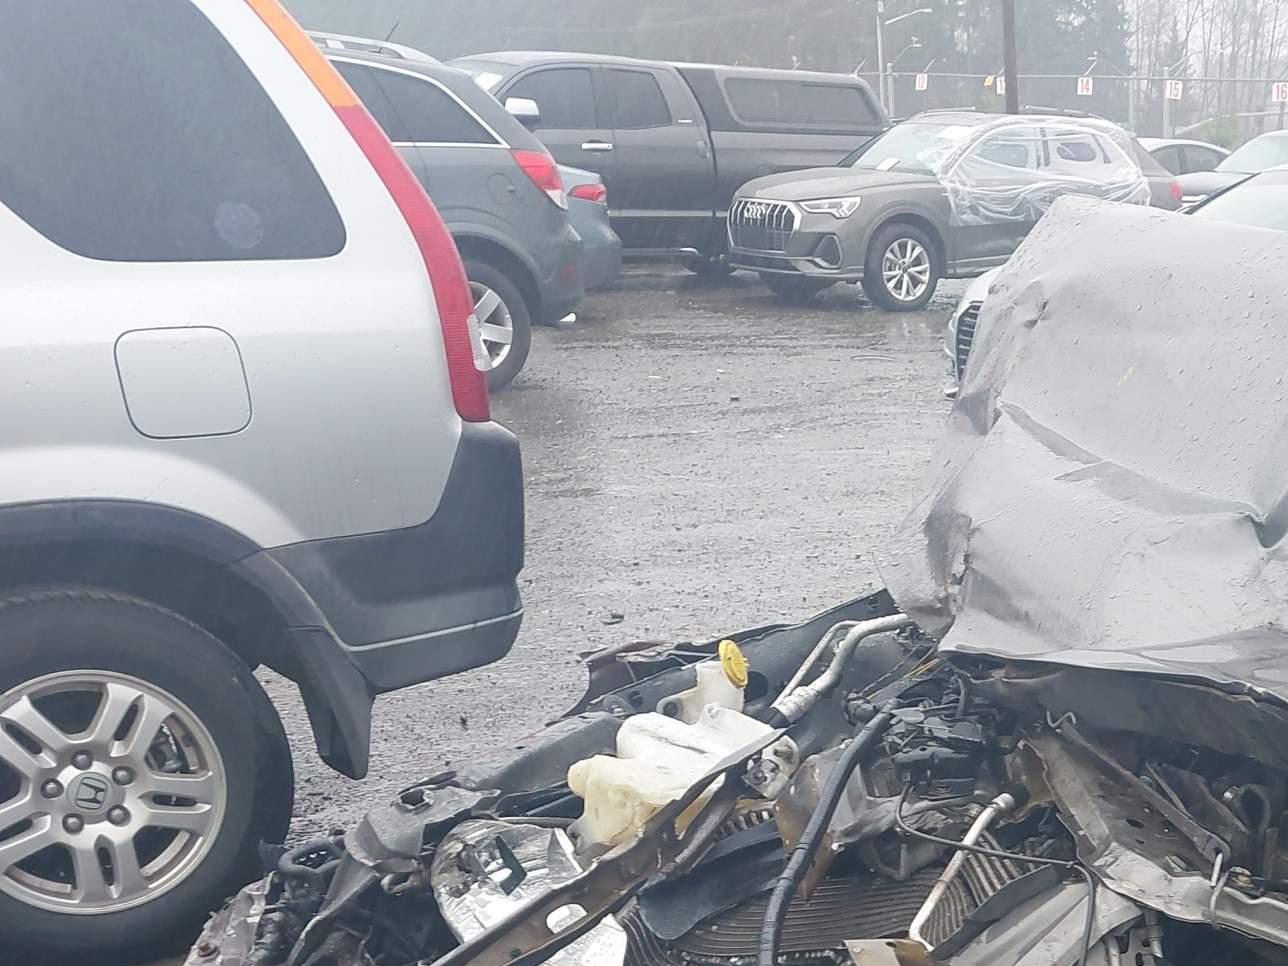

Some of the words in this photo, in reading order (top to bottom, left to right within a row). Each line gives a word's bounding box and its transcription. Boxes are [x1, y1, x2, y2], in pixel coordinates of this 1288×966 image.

[1080, 78, 1090, 94] 14
[1168, 80, 1180, 98] 15
[1275, 83, 1288, 100] 16
